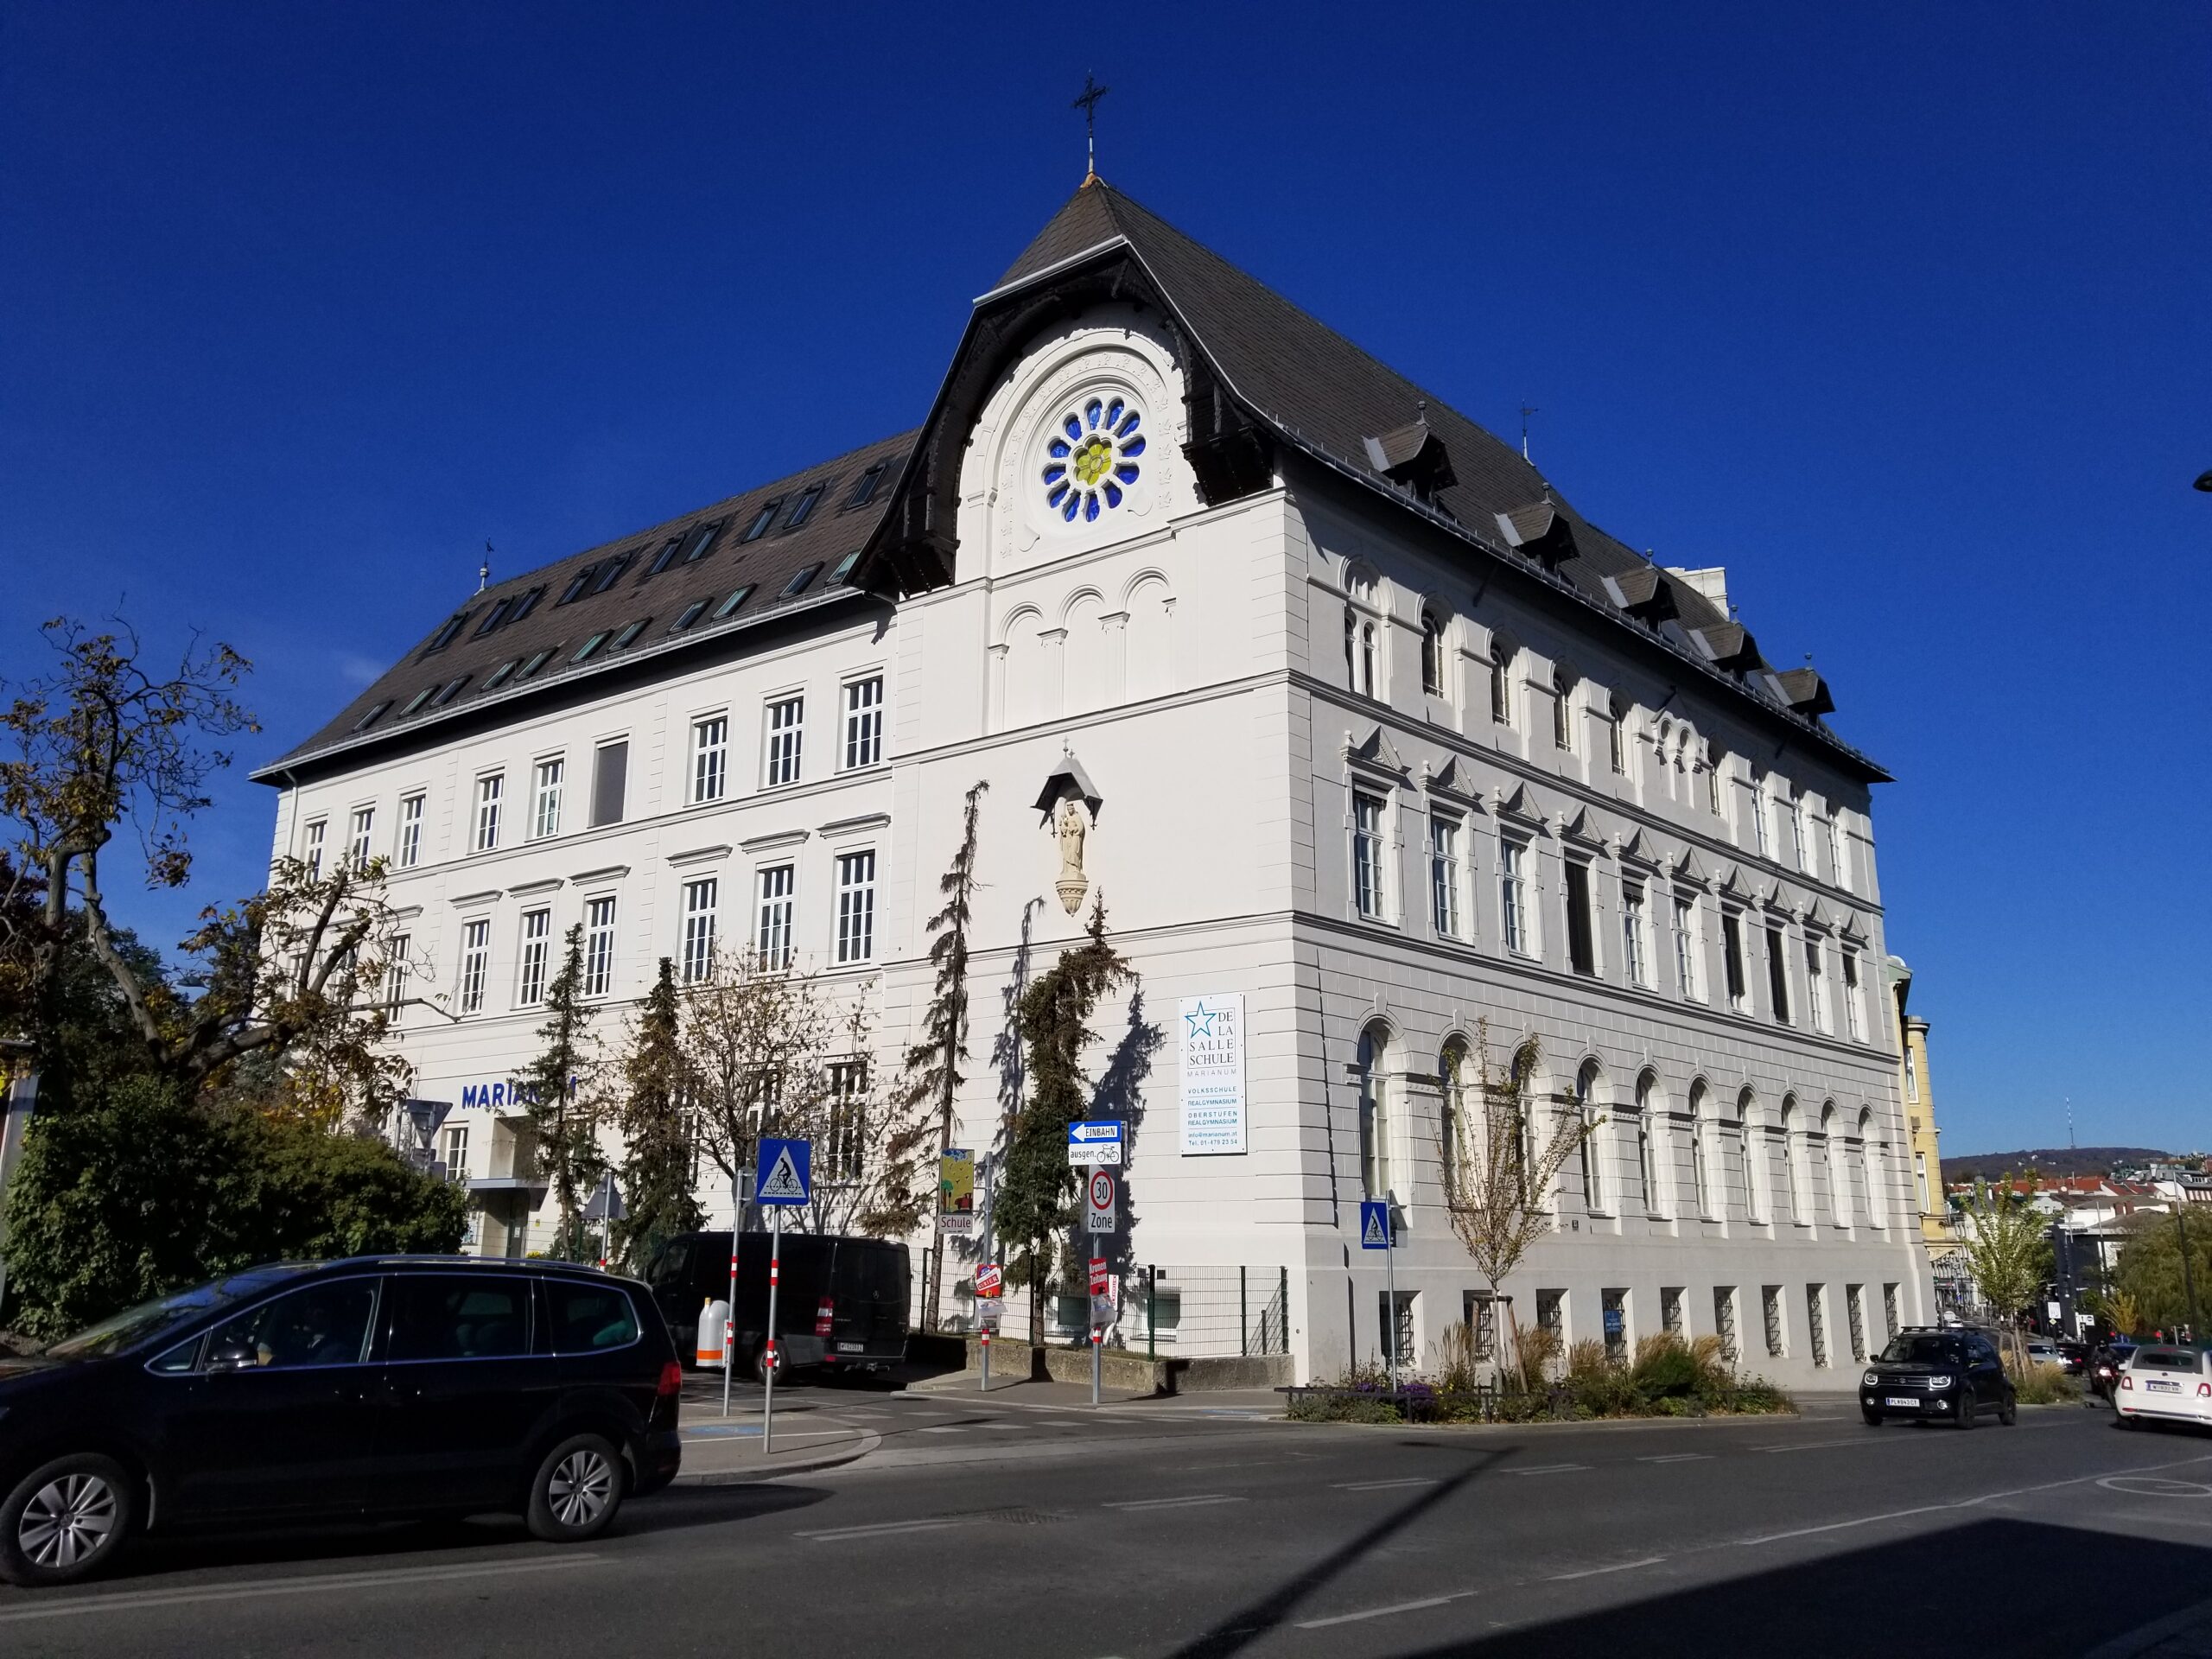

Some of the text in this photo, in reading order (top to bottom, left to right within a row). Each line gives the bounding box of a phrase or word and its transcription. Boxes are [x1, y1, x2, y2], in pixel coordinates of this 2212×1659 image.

[1218, 1011, 1234, 1022] DE
[1218, 1025, 1234, 1036] LA
[1189, 1038, 1234, 1052] SALLE
[1189, 1052, 1234, 1066] SCHULE
[1187, 1068, 1236, 1077] MARIANUM
[1188, 1085, 1236, 1094] VOLKSSCHULE
[1188, 1098, 1237, 1107] REALGYMNASIUM
[1188, 1110, 1237, 1119] OBERSTUFEN
[1188, 1118, 1237, 1127] REALGYMNASIUM
[1085, 1127, 1116, 1137] EINBAHN
[1070, 1150, 1096, 1160] ausgen.
[1096, 1181, 1108, 1199] 30
[941, 1216, 971, 1228] Schule
[1090, 1212, 1113, 1229] Zone
